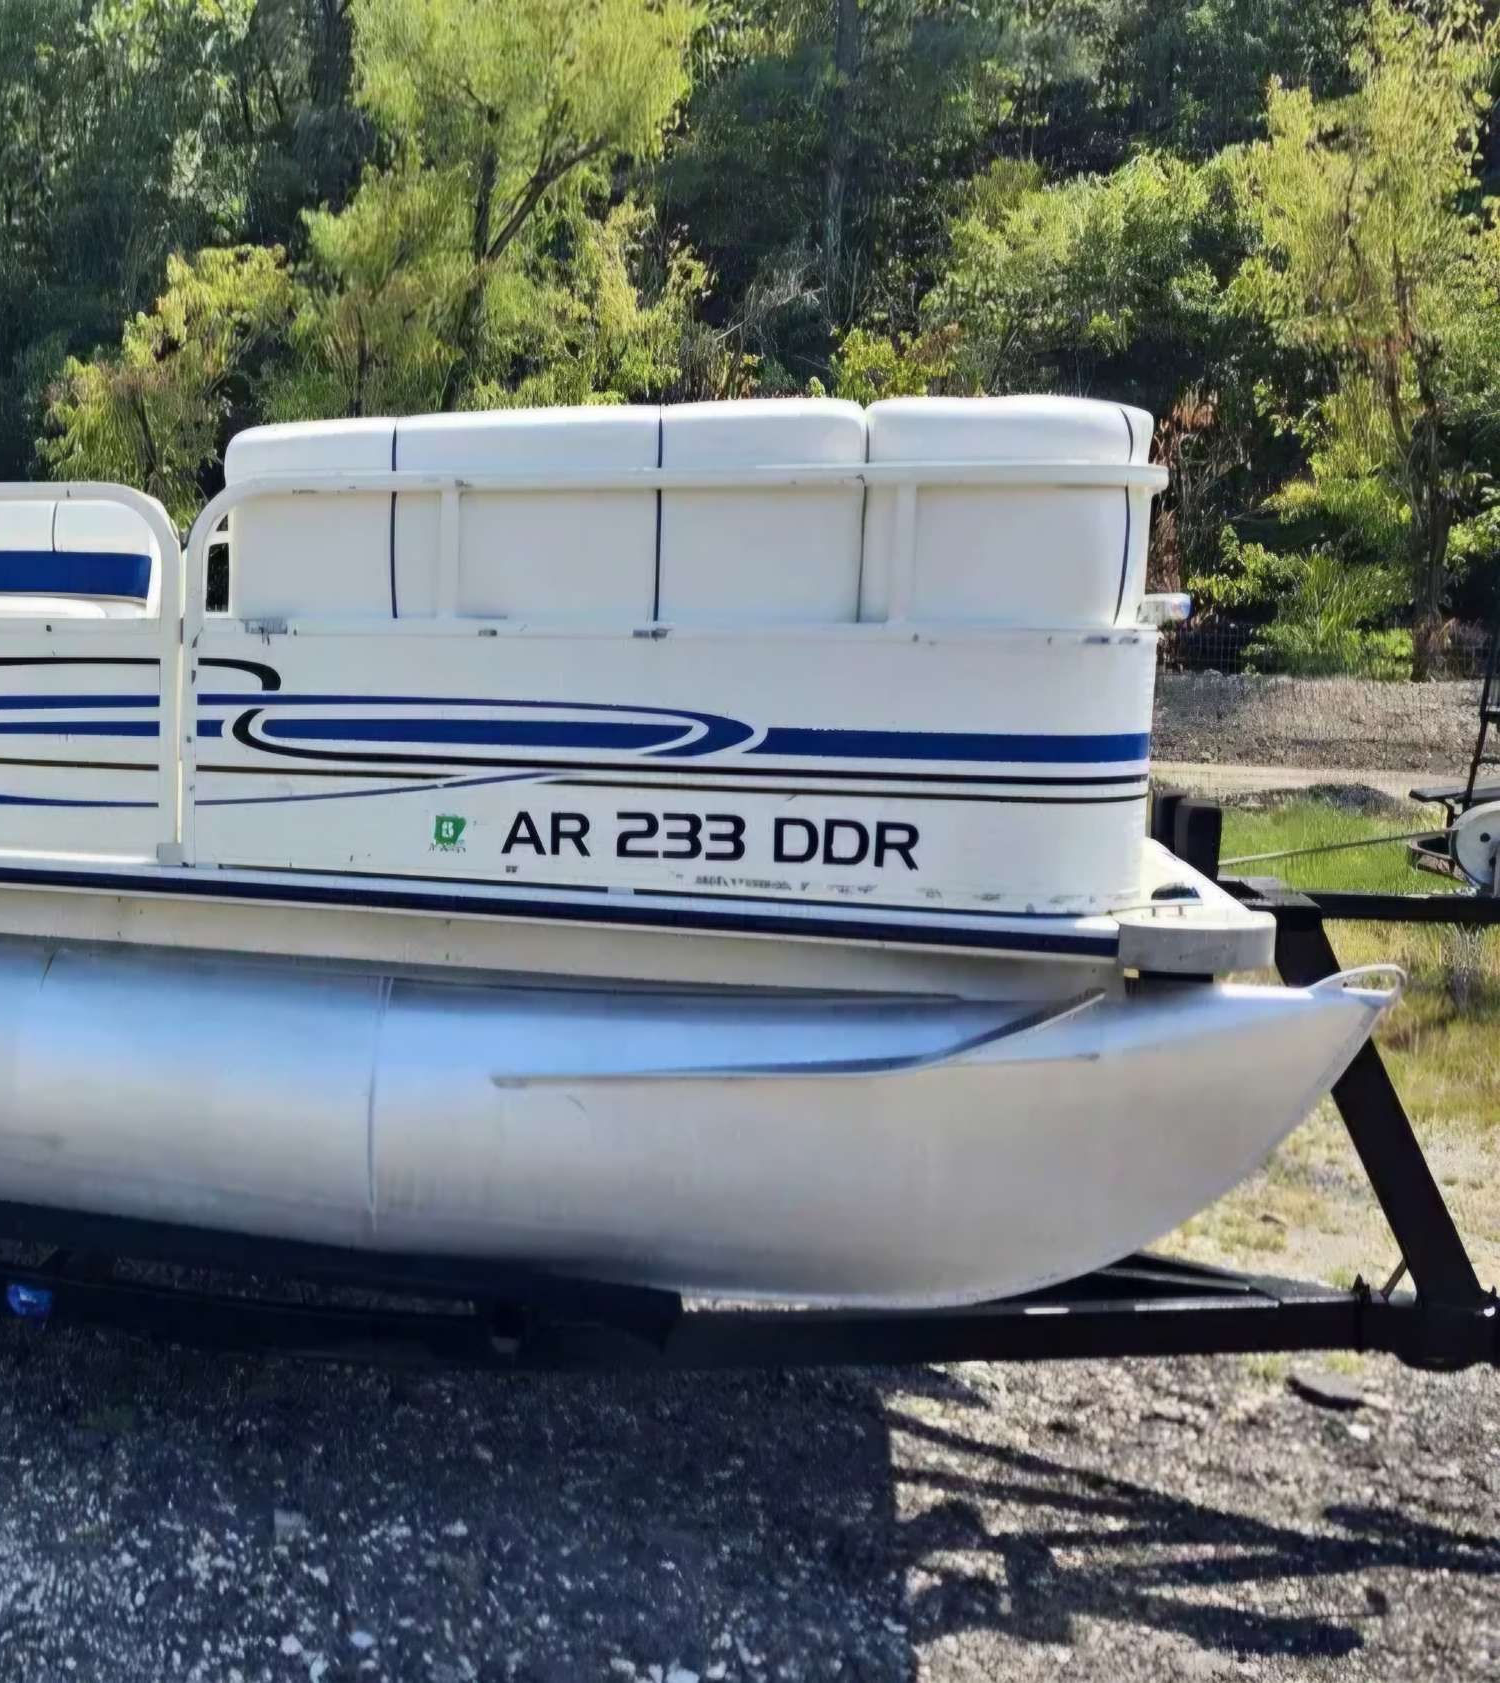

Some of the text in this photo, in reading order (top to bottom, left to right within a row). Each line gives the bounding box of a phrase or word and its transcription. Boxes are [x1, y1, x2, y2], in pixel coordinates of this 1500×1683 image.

[501, 811, 920, 871] AR 233 DDR
